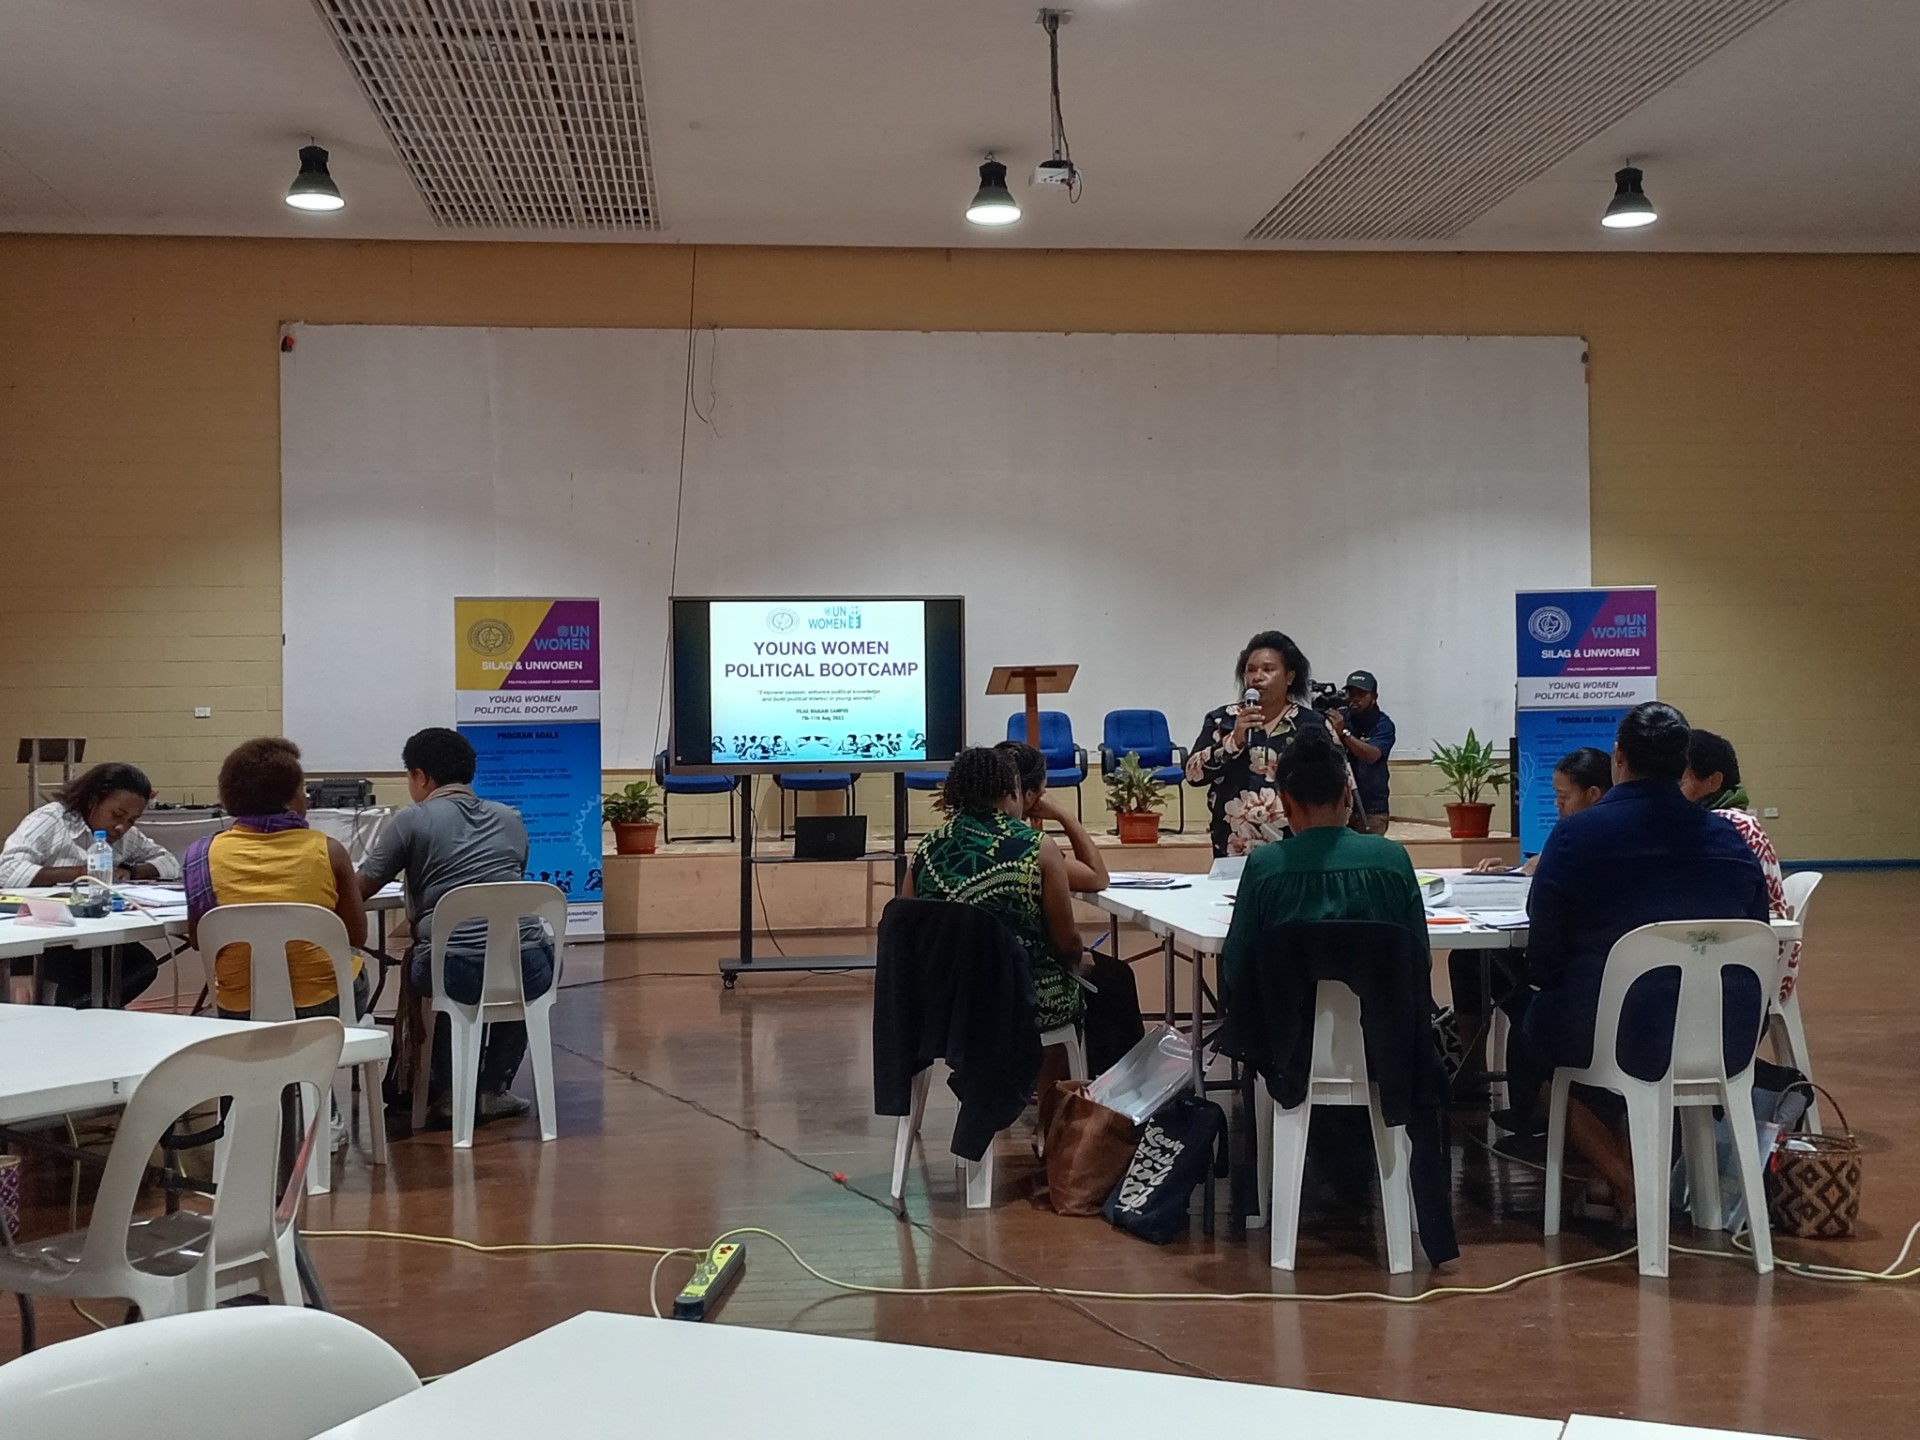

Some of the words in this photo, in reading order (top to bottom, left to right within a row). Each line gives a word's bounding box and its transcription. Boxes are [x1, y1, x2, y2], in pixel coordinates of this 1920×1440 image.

[832, 606, 846, 616] UN
[808, 618, 846, 629] WOMEN
[1626, 614, 1646, 625] UN
[570, 625, 590, 637] UN
[1592, 627, 1646, 638] WOMEN
[534, 639, 590, 650] WOMEN
[754, 642, 816, 656] YOUNG
[822, 640, 888, 655] WOMEN
[1541, 649, 1572, 659] SILAG
[1574, 649, 1582, 658] &
[1583, 648, 1640, 658] UNWOMEN
[482, 661, 512, 670] SILAG
[515, 661, 522, 670] &
[525, 660, 582, 670] UNWOMEN
[725, 663, 814, 678] POLITICAL
[820, 662, 918, 676] BOOTCAMP
[1548, 682, 1580, 690] YOUNG
[488, 696, 522, 704] YOUNG
[1582, 691, 1636, 699] BOOTCAMP
